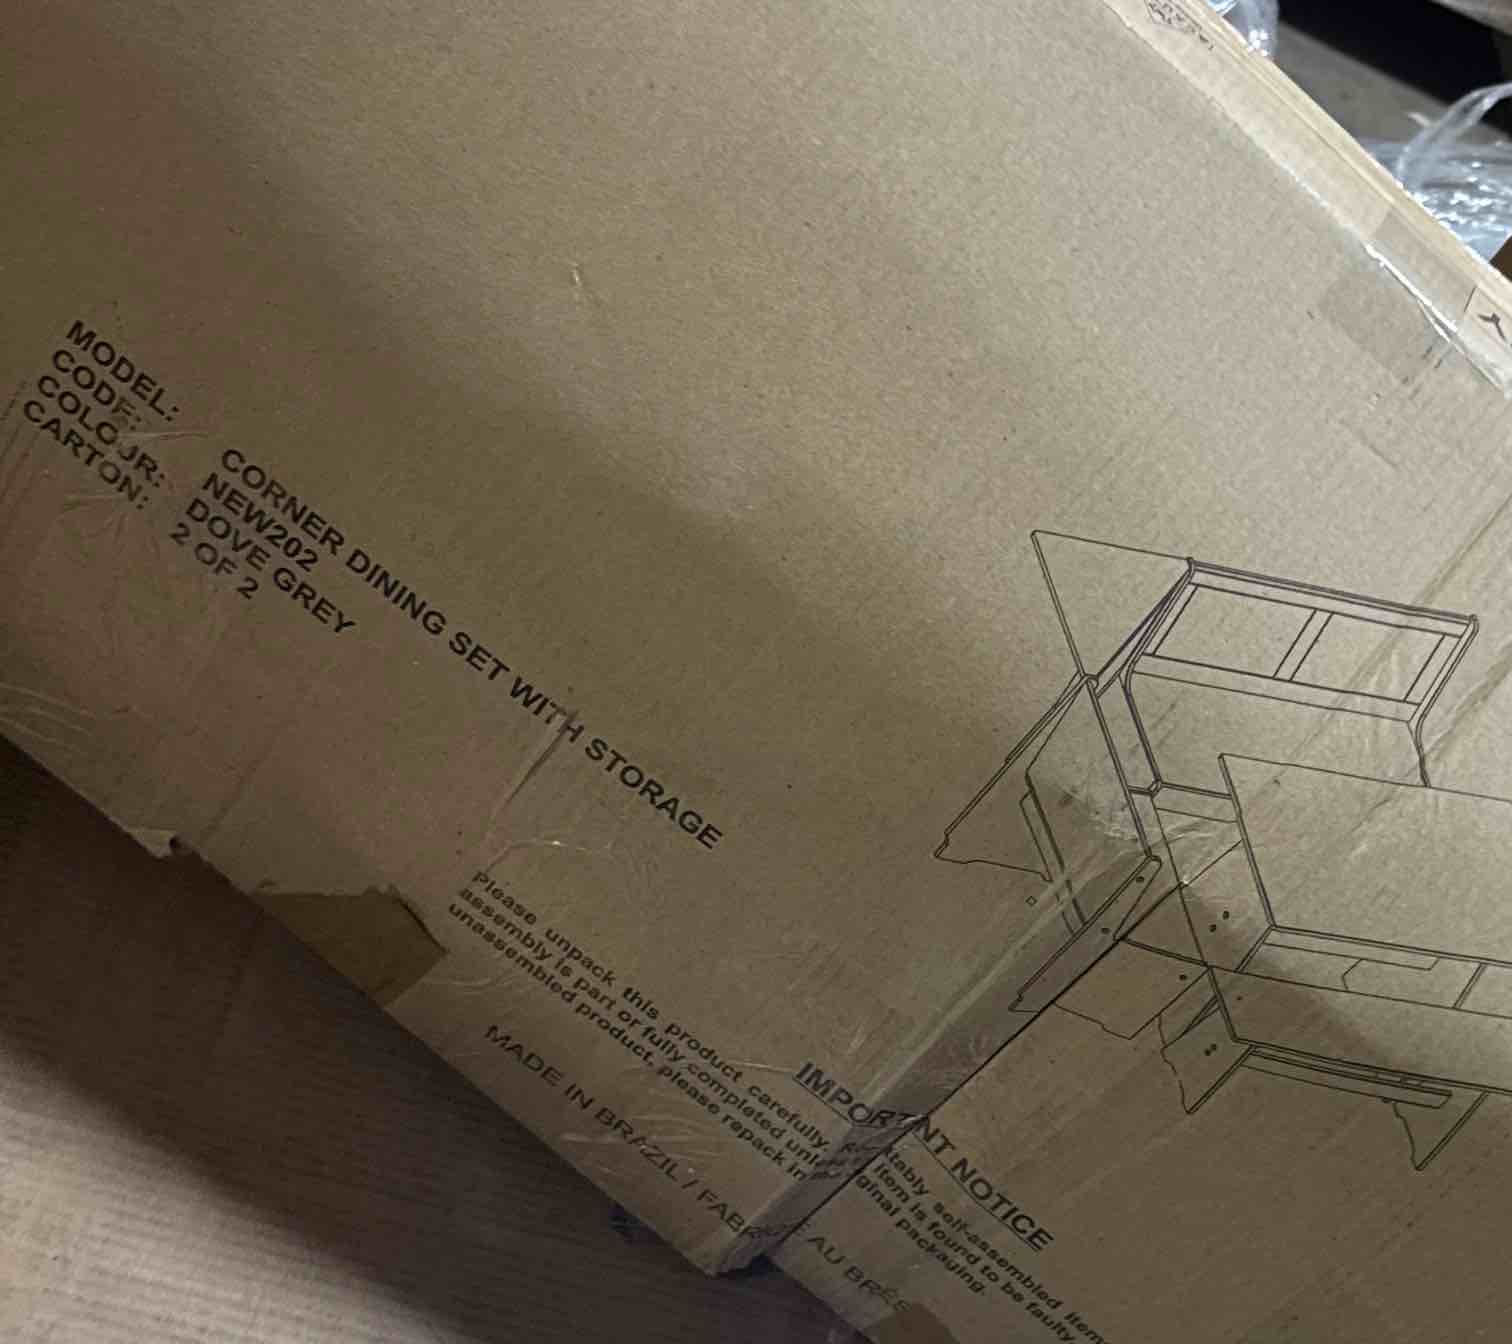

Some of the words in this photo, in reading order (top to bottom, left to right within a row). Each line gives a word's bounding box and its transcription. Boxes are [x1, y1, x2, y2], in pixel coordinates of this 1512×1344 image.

[17, 395, 154, 510] CARTON:
[167, 519, 195, 548] 2
[189, 537, 238, 582] OF
[234, 573, 262, 601] 2
[62, 319, 184, 423] MODEL:
[217, 445, 347, 555] CORNER
[343, 547, 450, 639] DINING
[445, 628, 509, 686] SET
[504, 674, 586, 746] WITH
[580, 733, 727, 851] STORAGE
[183, 495, 273, 573] DOVE
[267, 562, 356, 639] GREY
[198, 470, 322, 575] NEW202
[445, 899, 580, 1006] unassembled
[655, 1063, 723, 1119] please
[718, 1110, 791, 1170] repack
[455, 883, 557, 965] assembly
[571, 972, 618, 1013] part
[615, 1006, 642, 1031] or
[638, 1024, 690, 1068] fully
[683, 1059, 786, 1142] completed
[468, 869, 541, 929] Please
[541, 924, 619, 990] unpack
[620, 985, 663, 1023] this
[663, 1019, 744, 1086] product
[481, 1020, 565, 1090] MADE
[562, 1082, 593, 1111] IN
[590, 1105, 686, 1184] BRAZIL
[948, 1156, 1054, 1254] NOTICE
